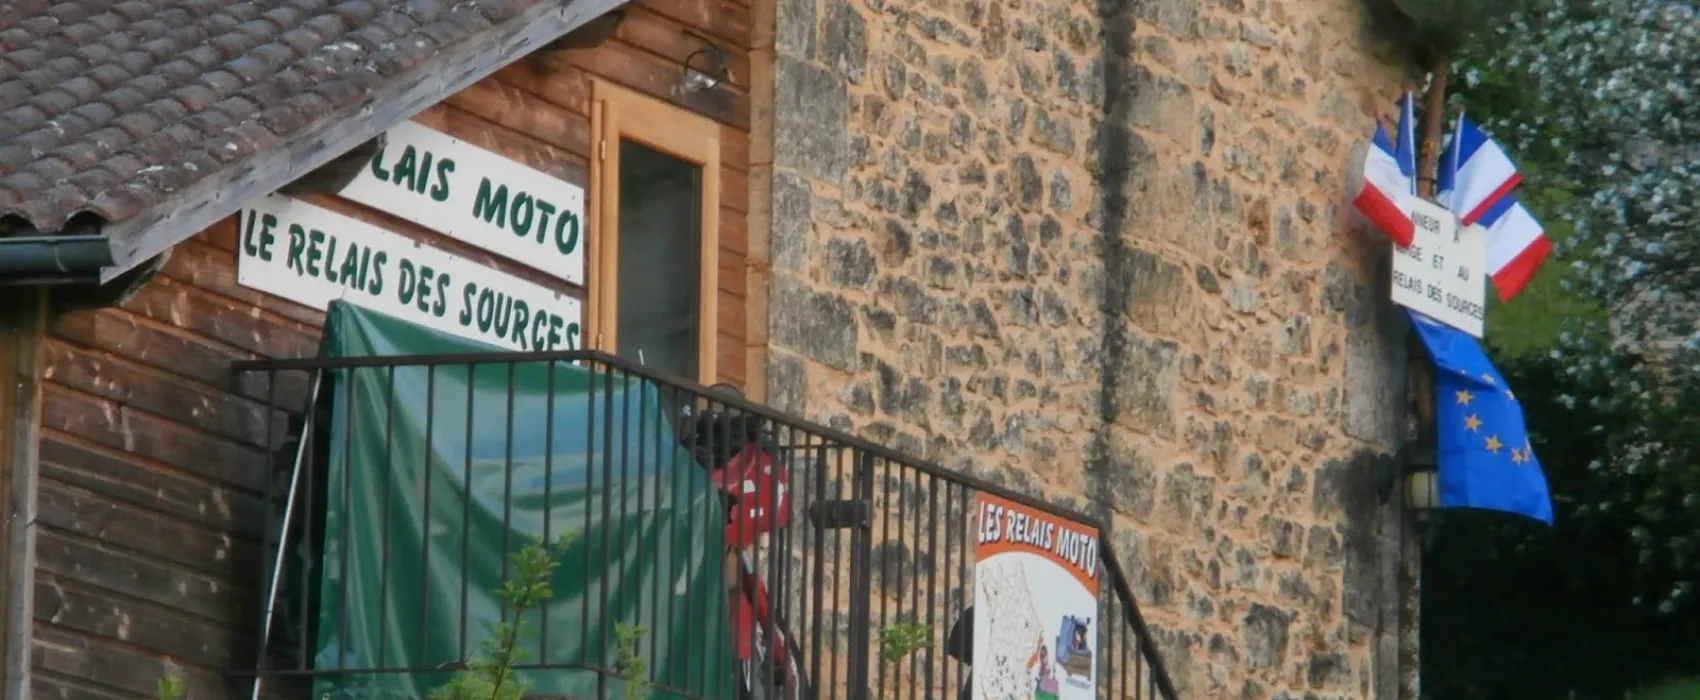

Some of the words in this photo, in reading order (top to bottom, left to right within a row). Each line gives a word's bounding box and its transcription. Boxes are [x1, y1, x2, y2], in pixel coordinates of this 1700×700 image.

[472, 176, 579, 256] MOTO
[244, 208, 278, 262] LE
[287, 223, 387, 296] RELAIS
[398, 258, 451, 318] DES
[459, 282, 579, 352] SOURCES
[1392, 270, 1422, 295] RELAIS
[1427, 283, 1443, 304] DES
[1446, 292, 1484, 321] SOURCES
[1432, 253, 1445, 270] ET
[1456, 264, 1470, 282] AU
[978, 499, 1004, 545] LES
[1006, 509, 1055, 552] RELAIS
[1056, 525, 1098, 580] MOTO
